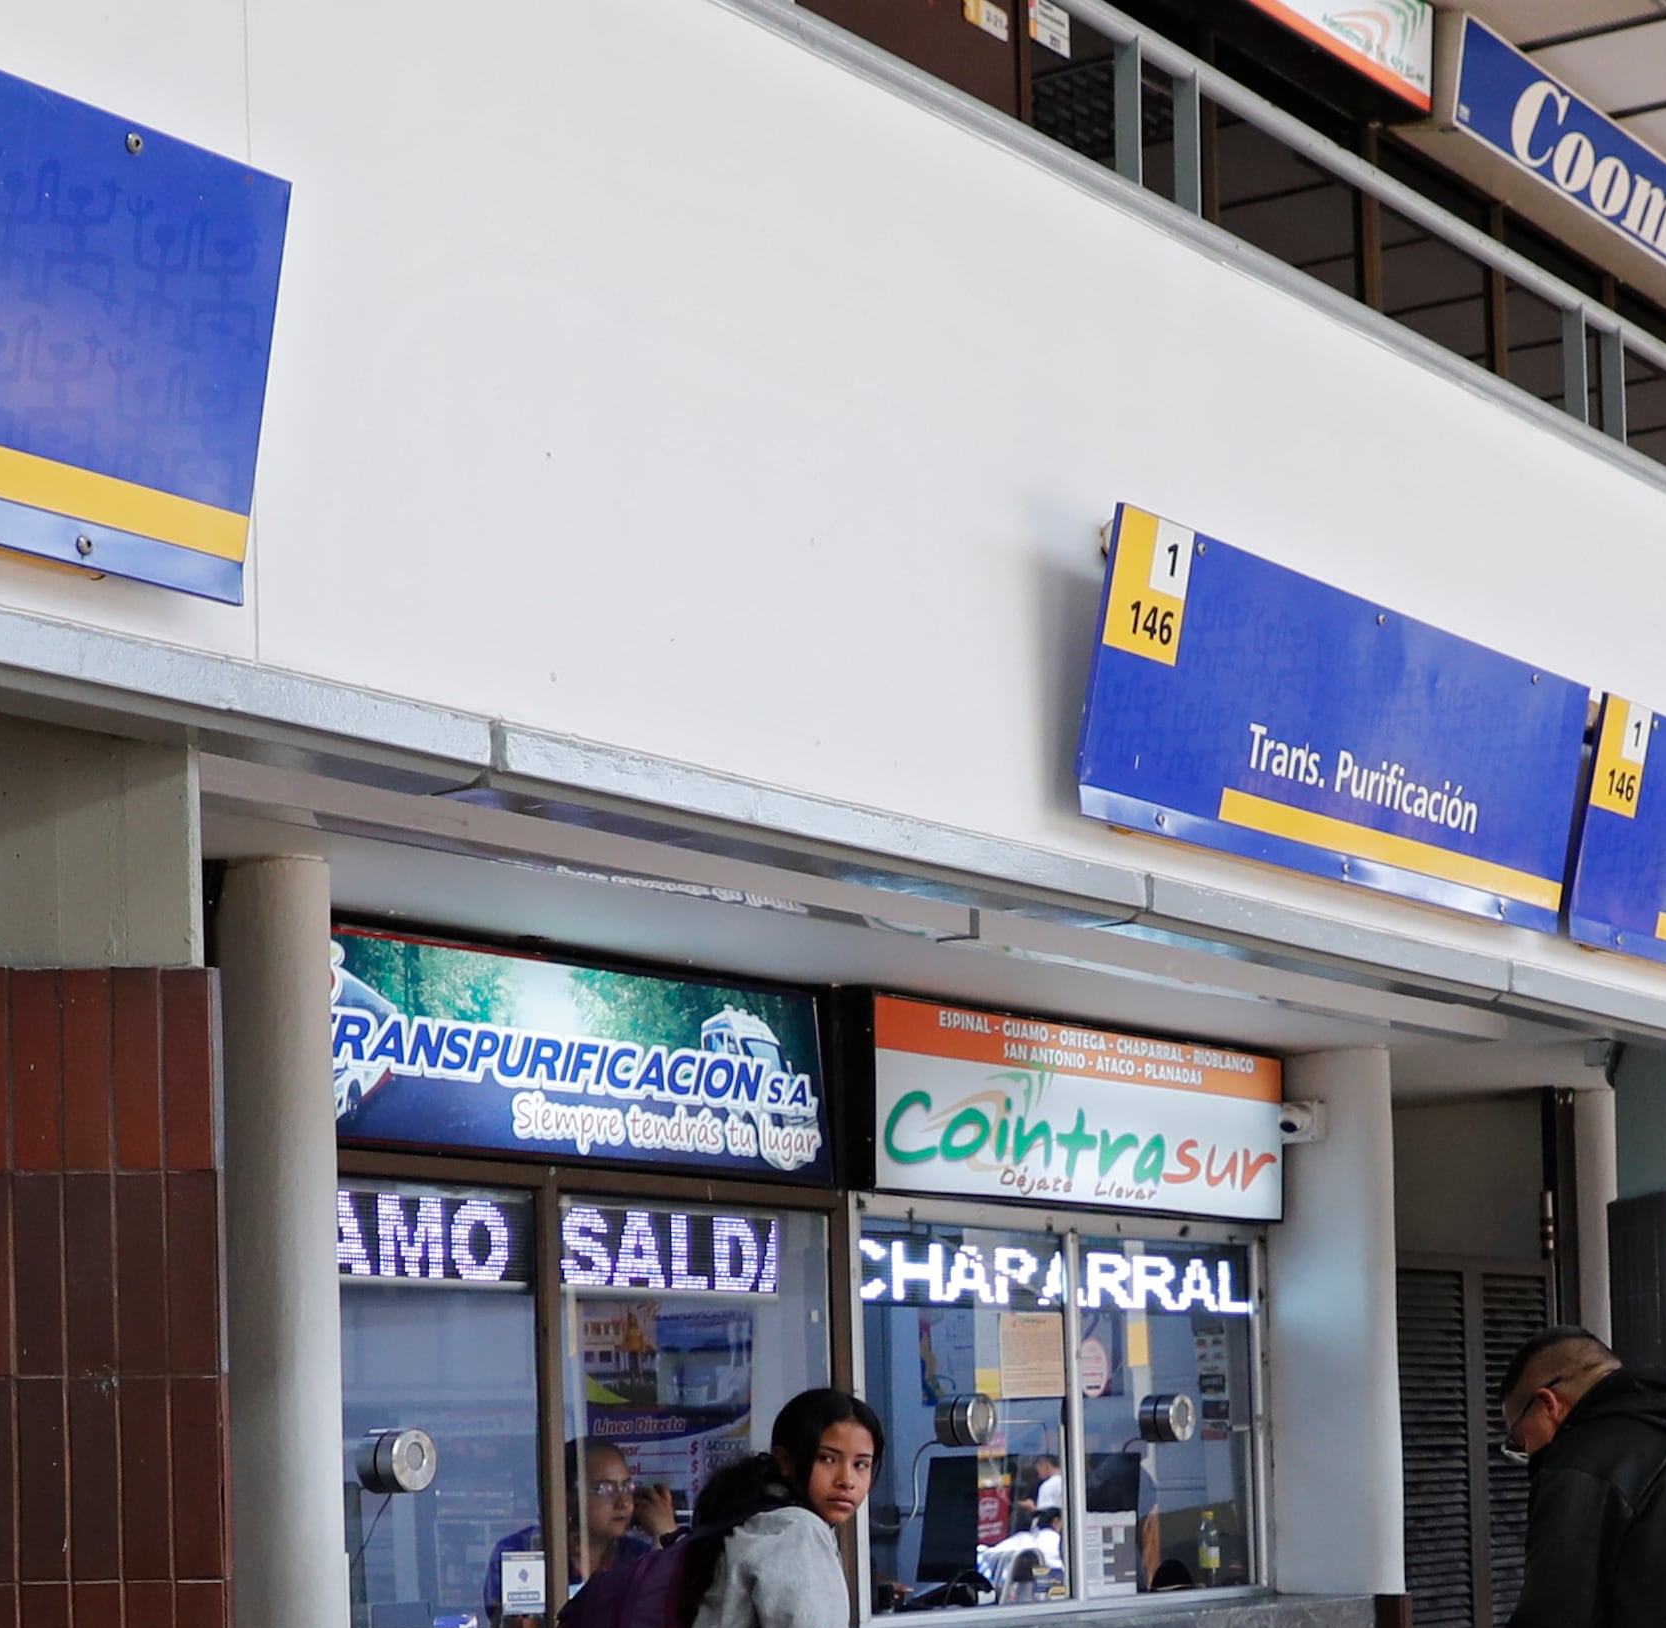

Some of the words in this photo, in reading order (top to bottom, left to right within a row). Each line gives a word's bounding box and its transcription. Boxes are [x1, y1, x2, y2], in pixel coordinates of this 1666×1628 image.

[1167, 542, 1180, 578] 1
[1130, 600, 1175, 646] 146
[1633, 720, 1643, 748] 1
[1248, 722, 1326, 789] Trans.
[1334, 748, 1480, 835] Purificación
[1607, 768, 1636, 803] 146
[331, 1012, 767, 1102] RANSPURIFICACION
[938, 1010, 992, 1036] ESPINAL
[1002, 1018, 1049, 1044] GUAMO
[1059, 1028, 1107, 1052] ORTEGA
[1116, 1037, 1185, 1064] CHAPARRAL
[1193, 1047, 1255, 1075] RIOBLANCO
[1003, 1042, 1032, 1061] SAN
[1031, 1046, 1087, 1071] ANTONIO
[1096, 1057, 1136, 1078] ATACO
[1144, 1064, 1204, 1087] PLANADAS
[517, 1096, 621, 1149] Siempre
[630, 1110, 720, 1147] tendrás
[728, 1119, 754, 1149] tu
[761, 1121, 819, 1166] lugar
[883, 1088, 1278, 1193] Cointrasur
[999, 1165, 1074, 1198] Déjate
[1094, 1180, 1158, 1202] Llevar
[858, 1238, 1254, 1314] CHAPARRAL
